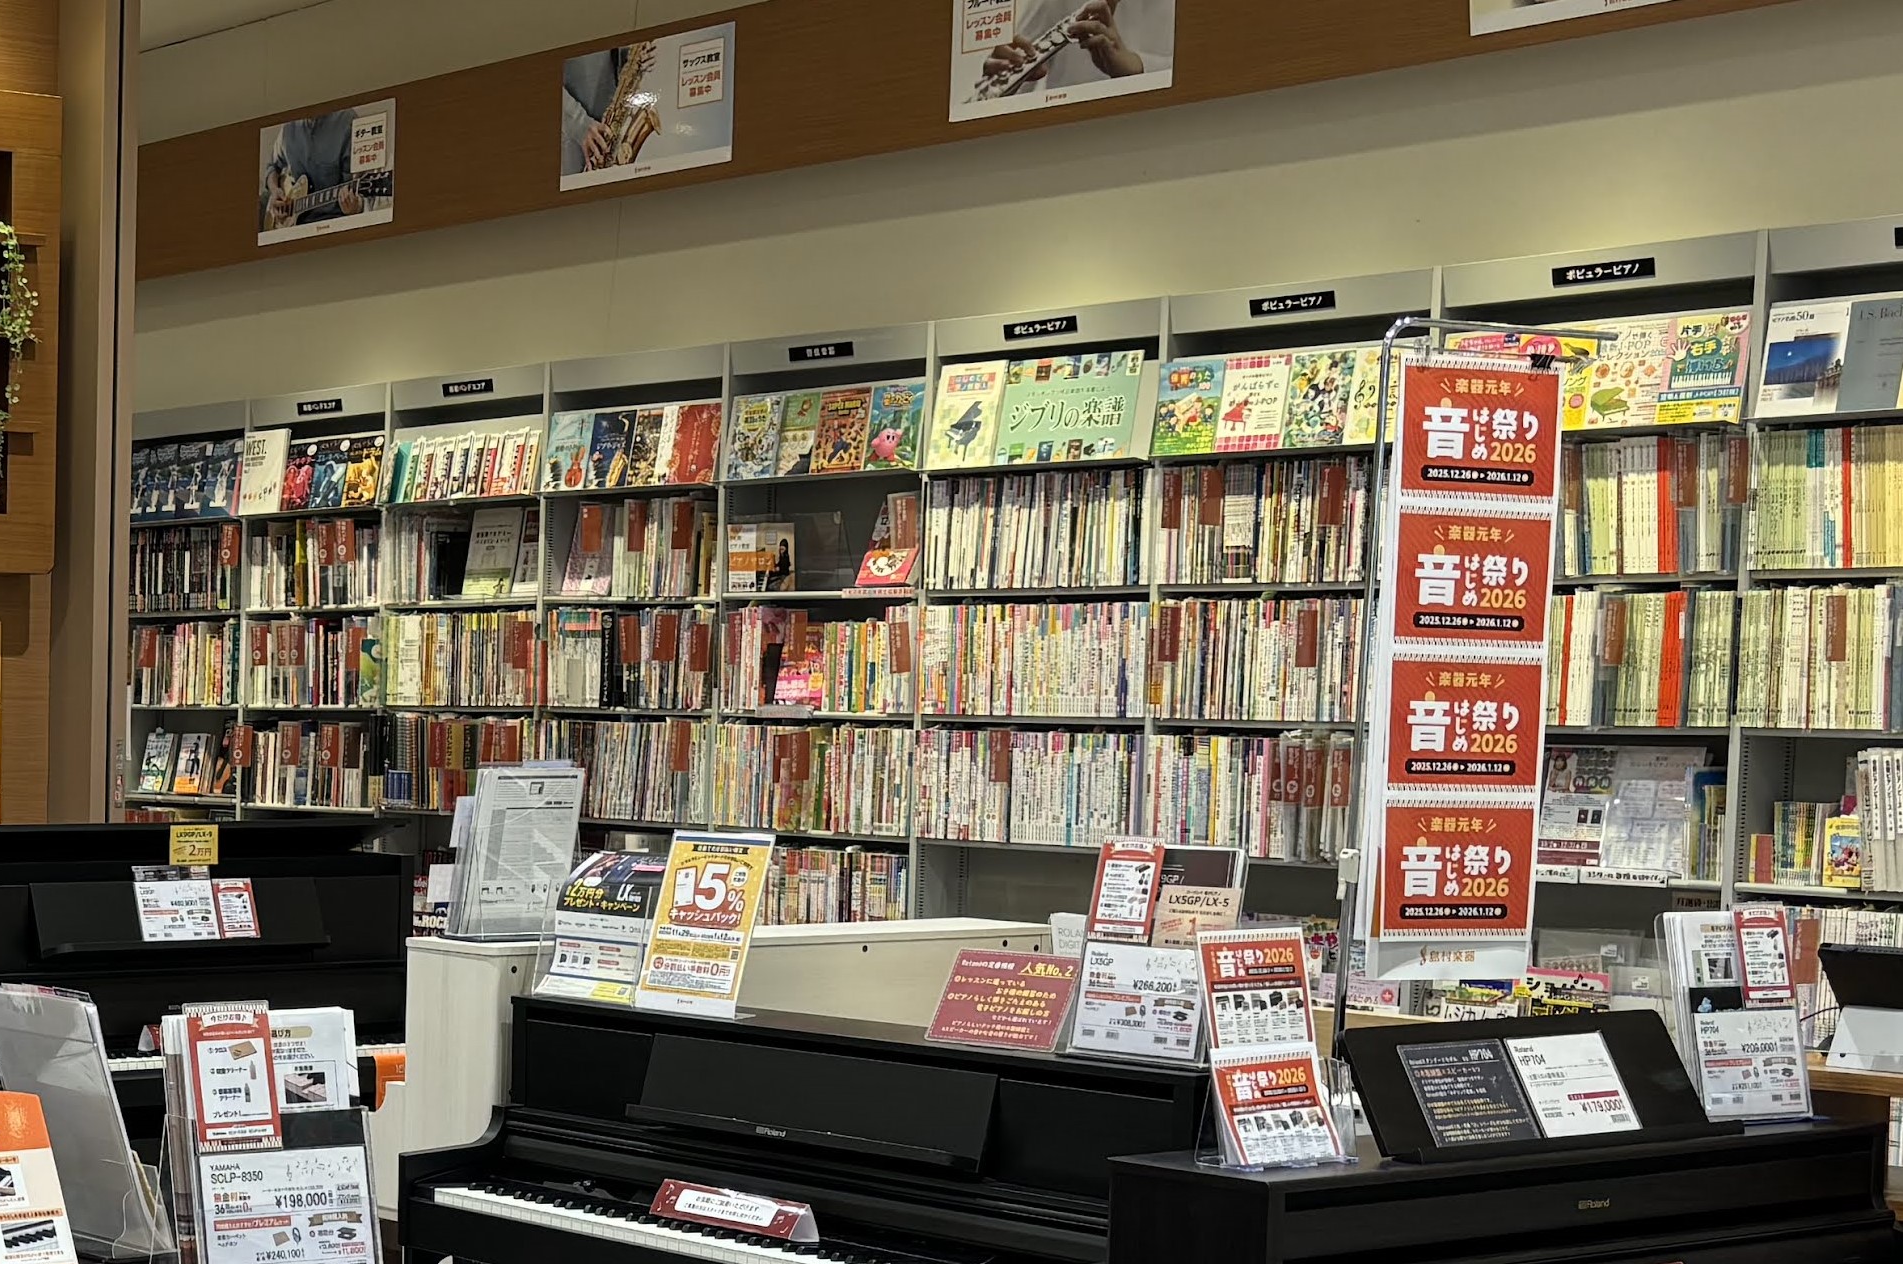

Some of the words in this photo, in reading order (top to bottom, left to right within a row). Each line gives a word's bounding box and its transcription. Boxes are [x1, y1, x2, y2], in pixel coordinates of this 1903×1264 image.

[966, 11, 1012, 29] レッスン会員
[1565, 263, 1640, 280] ポピュラーピアノ
[1261, 295, 1323, 312] ポピュラーピアノ
[1013, 319, 1067, 336] ポピュラーピアノ
[1009, 395, 1126, 432] ジブリの楽譜
[1422, 397, 1469, 460] 音
[1472, 407, 1488, 460] はじめ
[1492, 408, 1538, 441] 祭り
[1489, 442, 1536, 464] 2026
[1414, 544, 1461, 607] 音
[1462, 553, 1479, 607] はじめ
[1482, 554, 1528, 586] 祭り
[1479, 588, 1526, 609] 2026
[1406, 691, 1450, 752] 音
[1452, 700, 1469, 752] はじめ
[1472, 700, 1519, 731] 祭り
[1470, 734, 1517, 753] 2026
[1400, 836, 1442, 898] 音
[1444, 844, 1460, 898] はじめ
[1464, 844, 1511, 875] 祭り
[1461, 877, 1509, 897] 2026
[1168, 896, 1230, 907] LX5GP/LX-5
[669, 909, 741, 925] キャッシュバック!
[1264, 948, 1294, 964] 2026
[1700, 1026, 1719, 1034] HP704
[1518, 1055, 1546, 1066] HP704
[1276, 1067, 1306, 1085] 2026
[764, 1128, 786, 1137] Roland
[210, 1163, 240, 1172] YAMAHA
[210, 1171, 263, 1184] SCLP-8350
[275, 1192, 327, 1209] ¥198,000
[1587, 1198, 1610, 1209] Roland
